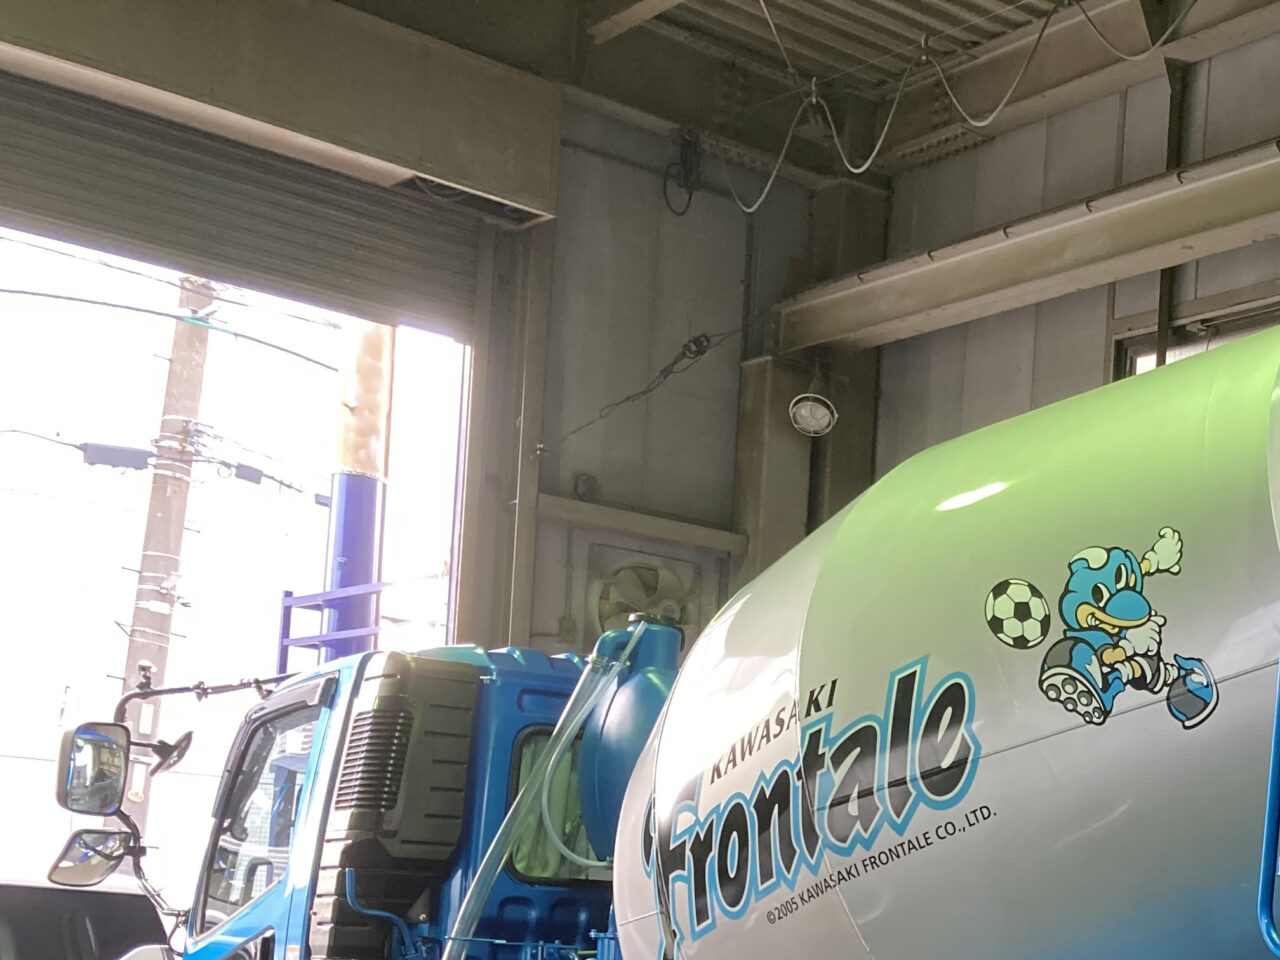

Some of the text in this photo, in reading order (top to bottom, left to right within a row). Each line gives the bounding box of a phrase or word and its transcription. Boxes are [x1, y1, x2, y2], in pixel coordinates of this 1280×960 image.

[709, 677, 838, 785] KAWASAKI
[766, 893, 799, 925] ©2005
[799, 863, 861, 906] KAWASAKI
[862, 831, 934, 873] FRONTALE
